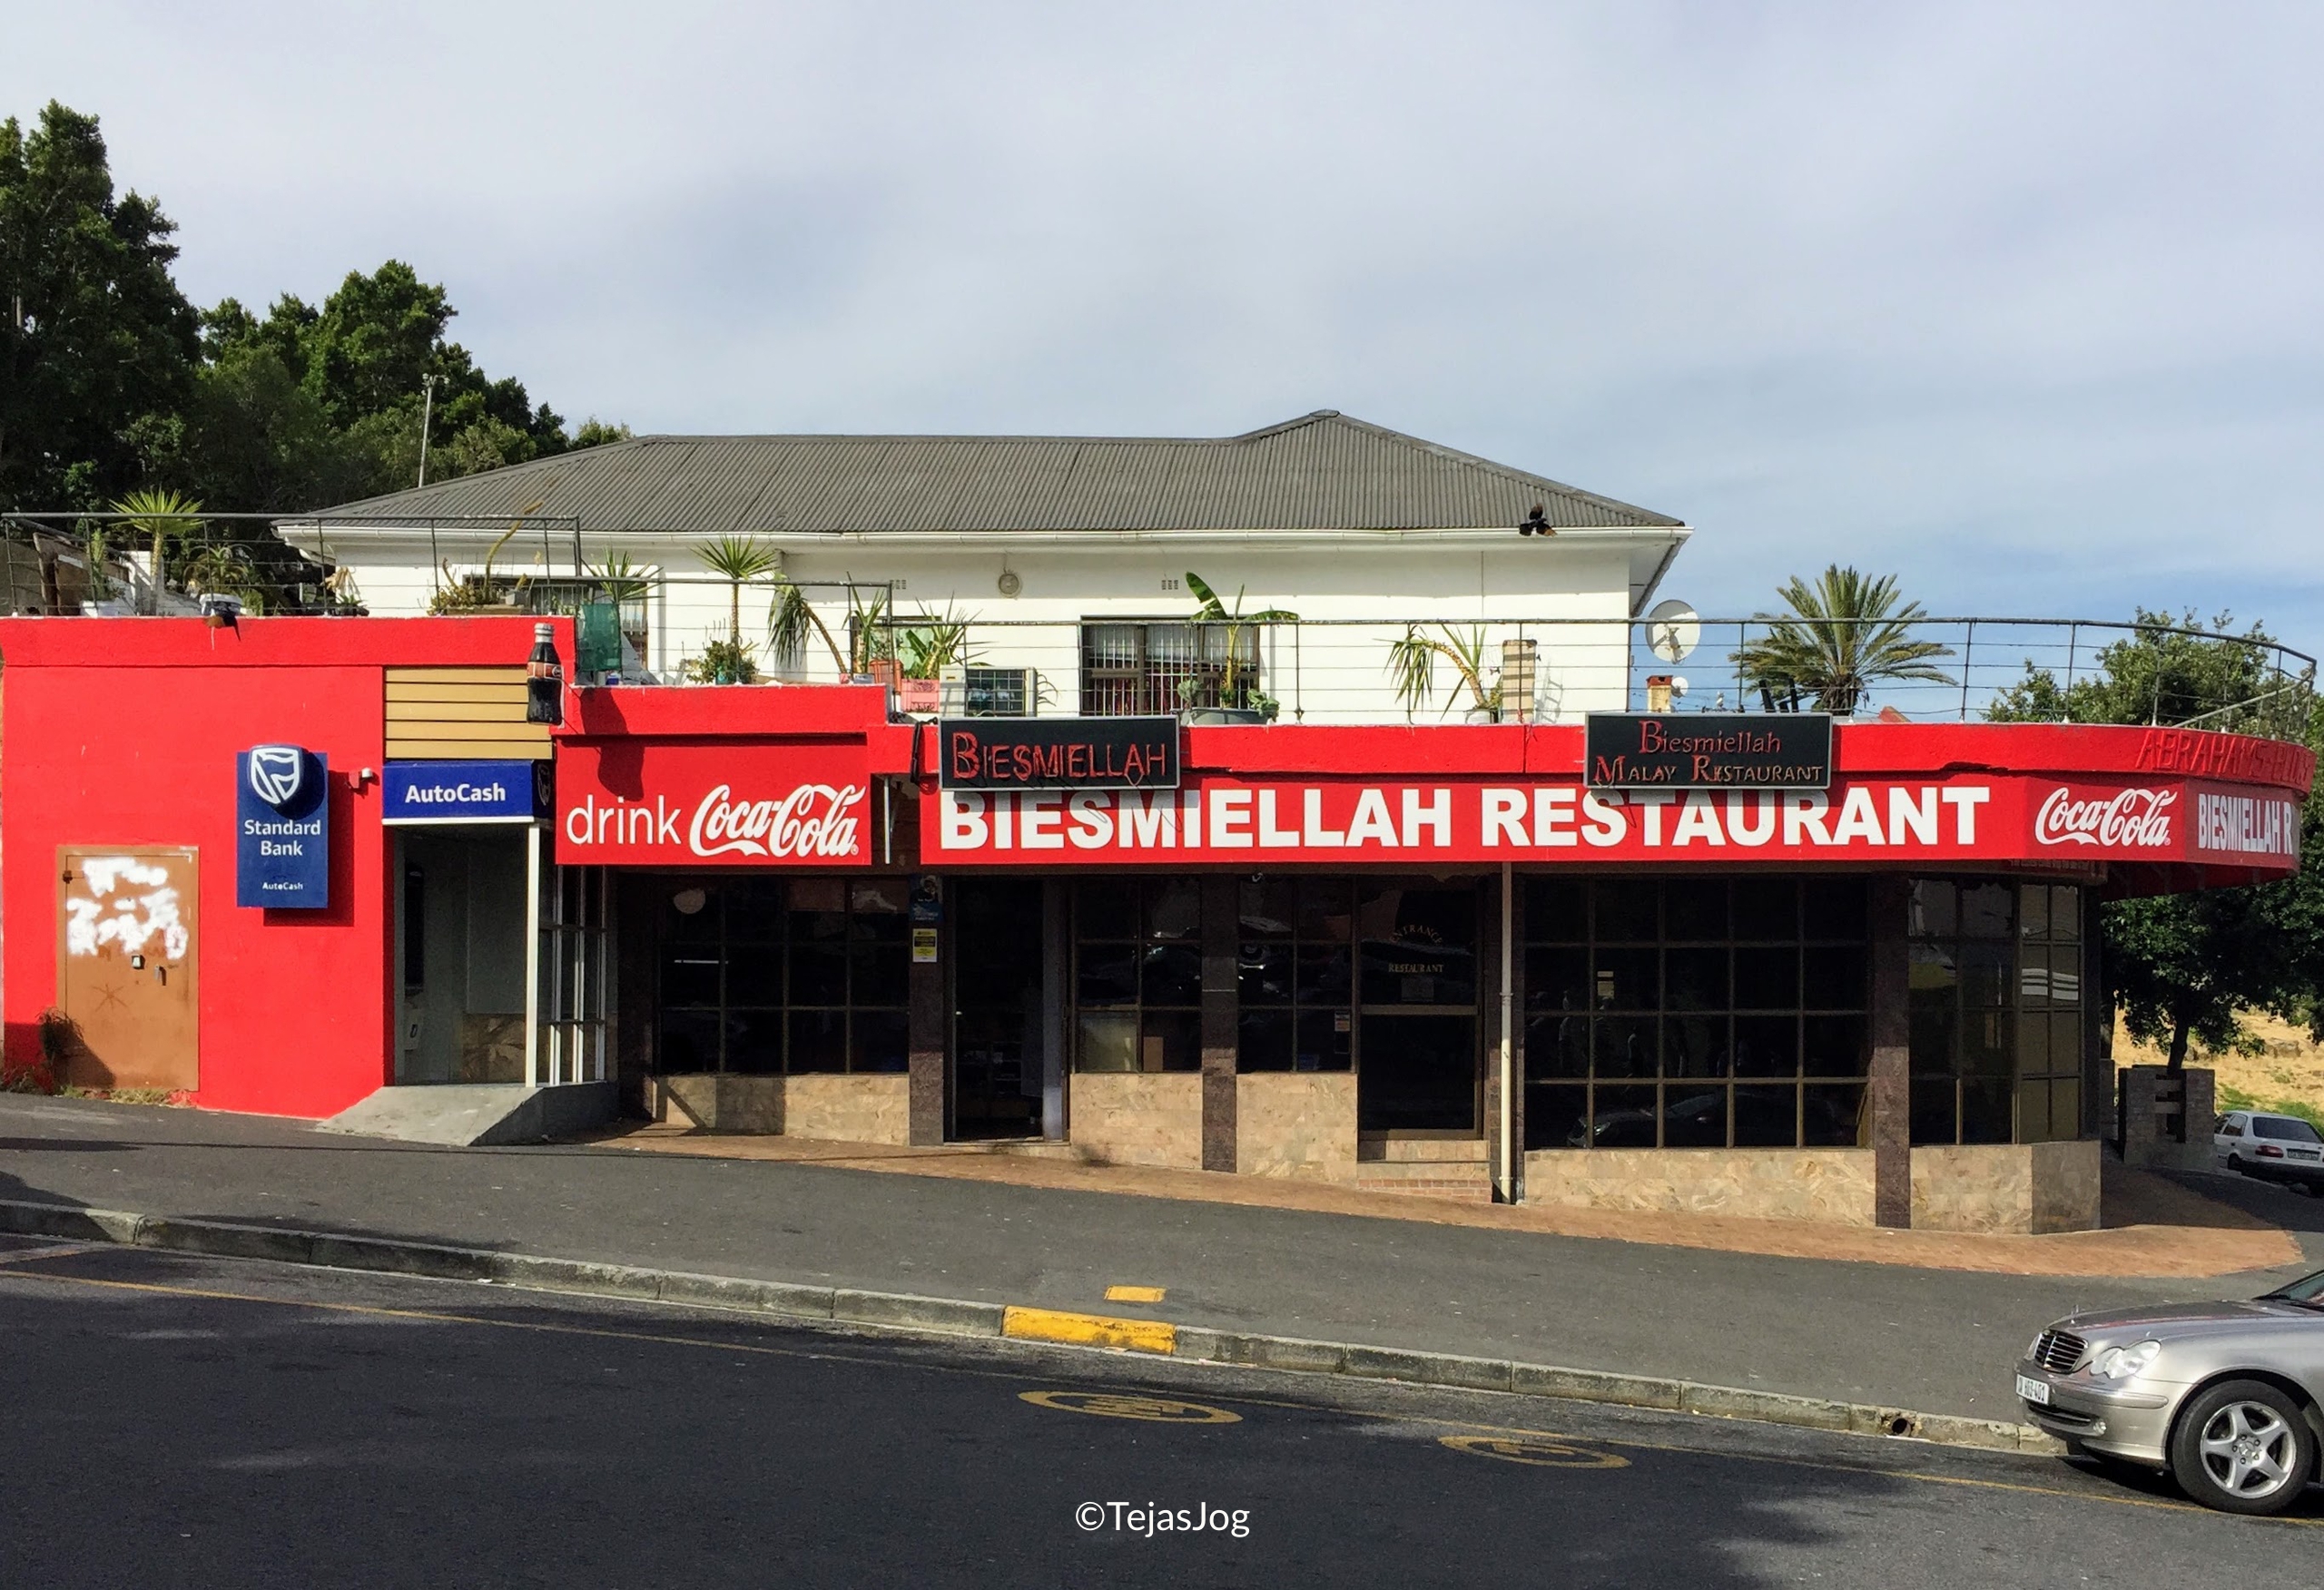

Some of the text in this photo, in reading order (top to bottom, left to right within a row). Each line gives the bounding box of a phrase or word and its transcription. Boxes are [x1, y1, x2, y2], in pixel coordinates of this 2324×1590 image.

[1639, 720, 1781, 754] Biesmiellah
[953, 731, 1166, 780] BIESMIELLAH
[1593, 754, 1823, 783] MALAY RESTAURANT
[405, 782, 506, 803] AutoCash
[244, 820, 320, 835] Standard
[566, 784, 866, 857] drink Coca-Cola
[940, 787, 1992, 849] BIESMIELLAH RESTAURANT
[2034, 787, 2177, 848] Coca-Cola
[2198, 793, 2280, 854] BIESMIELLAH
[261, 840, 303, 856] Bank
[261, 882, 303, 890] AutoCash
[1388, 963, 1443, 973] RESTAURANT
